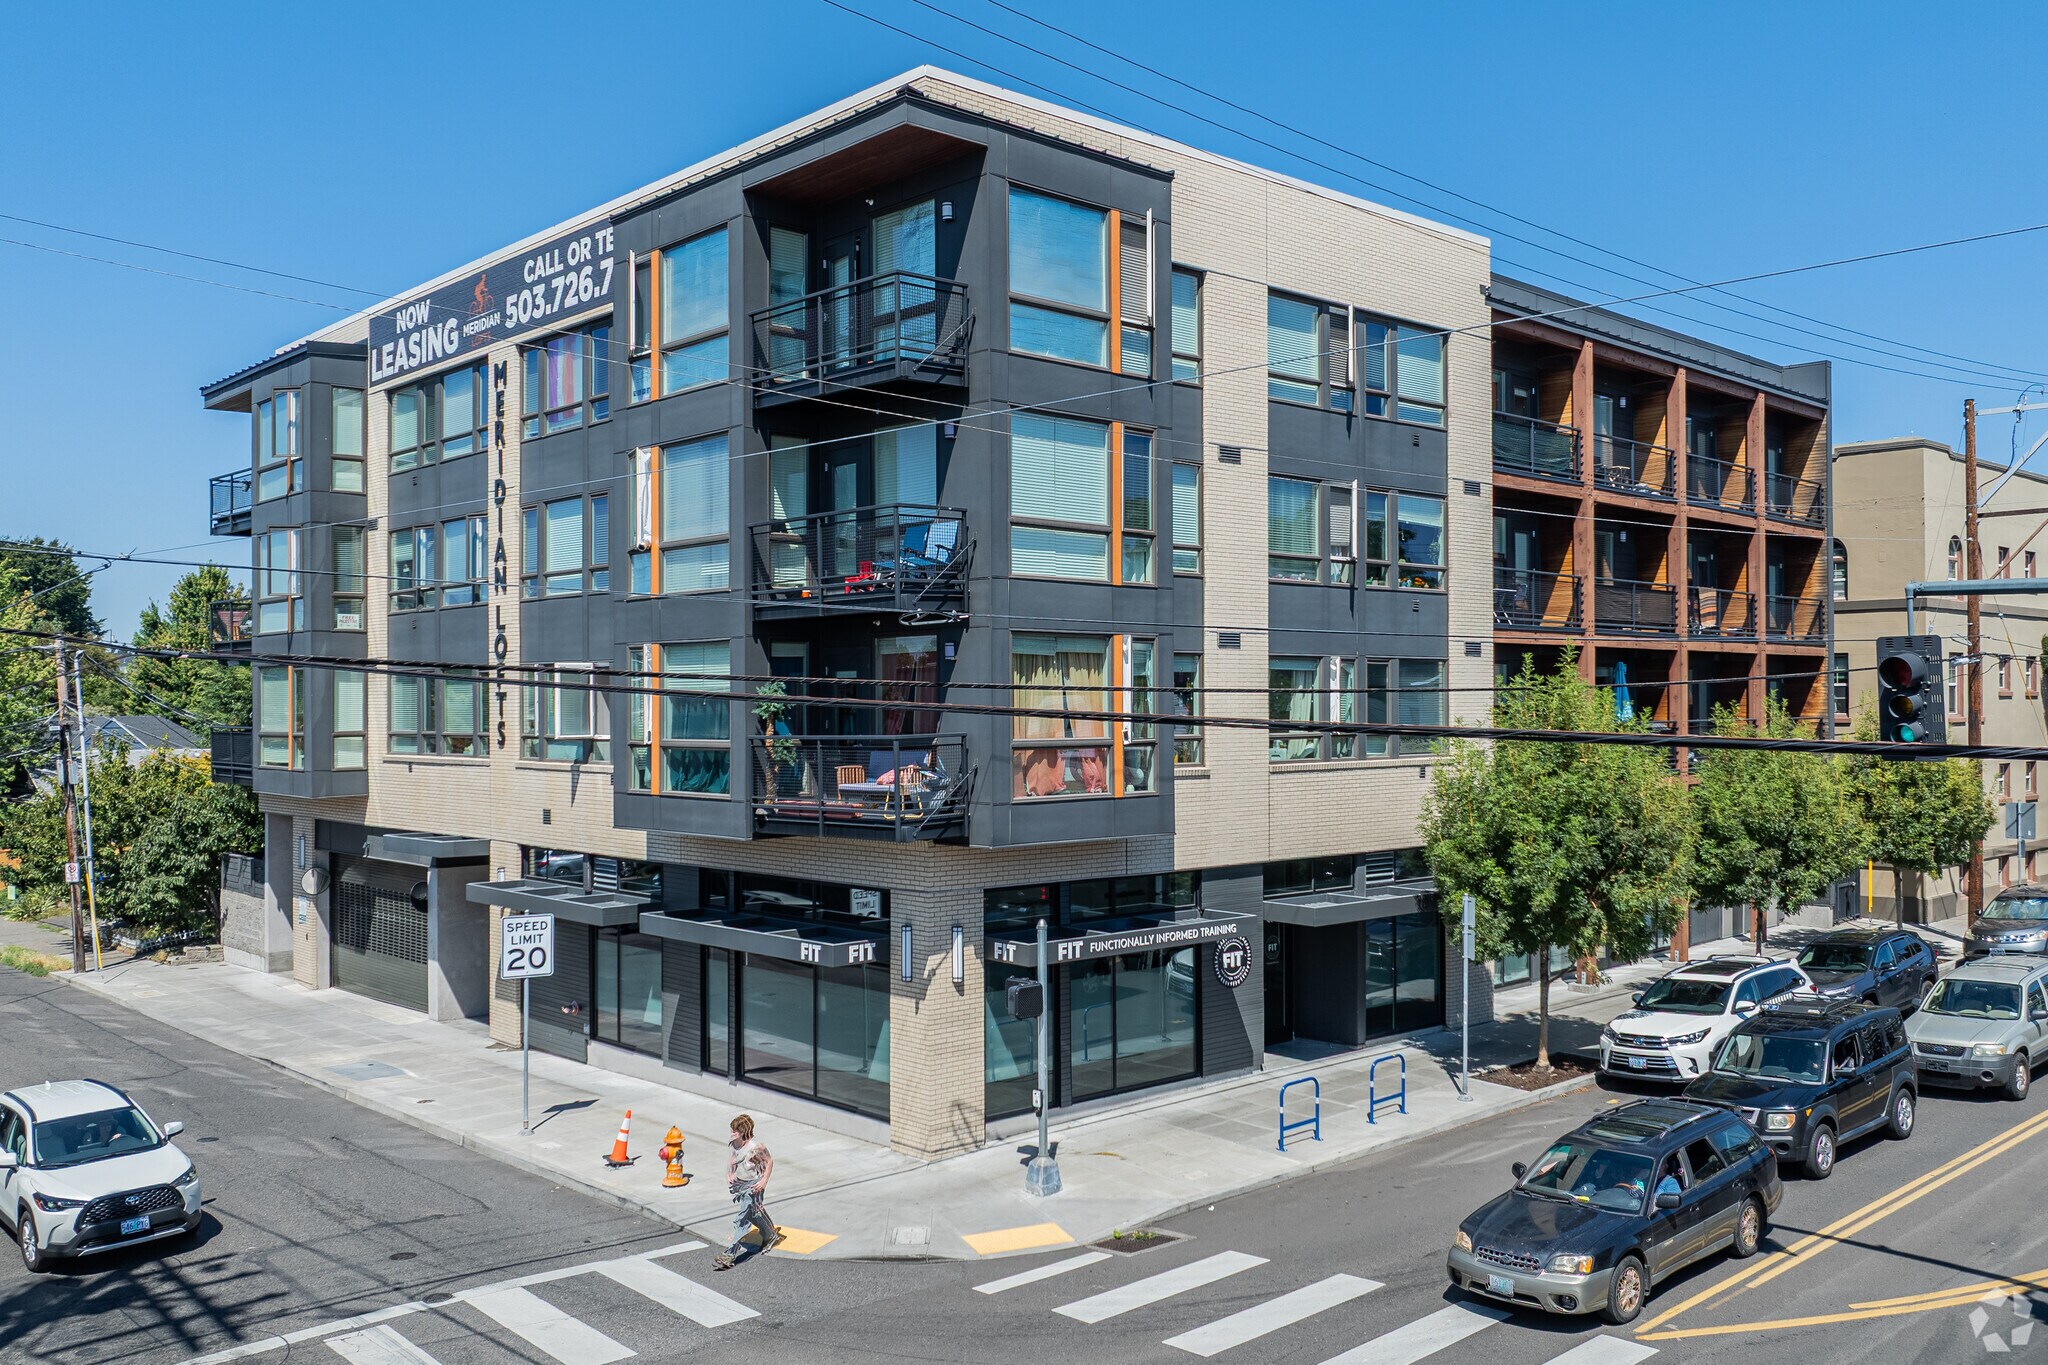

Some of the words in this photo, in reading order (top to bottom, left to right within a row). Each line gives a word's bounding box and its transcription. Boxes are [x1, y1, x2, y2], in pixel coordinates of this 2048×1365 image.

[523, 249, 564, 283] CALL
[567, 236, 592, 266] OR
[595, 226, 614, 255] TE
[504, 257, 614, 329] 503.726.7
[396, 299, 430, 334] NOW
[462, 312, 501, 338] MERIDIAN
[371, 317, 459, 382] LEASING
[494, 360, 507, 596] MERIDIAN
[507, 921, 548, 932] SPEED
[511, 934, 543, 945] LIMIT
[800, 942, 822, 962] FIT
[848, 942, 876, 964] FIT
[993, 941, 1017, 962] FIT
[1057, 940, 1084, 961] FIT
[1089, 934, 1155, 953] FUNCTIONALLY
[1155, 928, 1199, 944] INFORMED
[1200, 923, 1237, 938] TRAINING
[1267, 942, 1278, 952] FIT
[507, 946, 547, 972] 20
[1222, 950, 1243, 969] FIT
